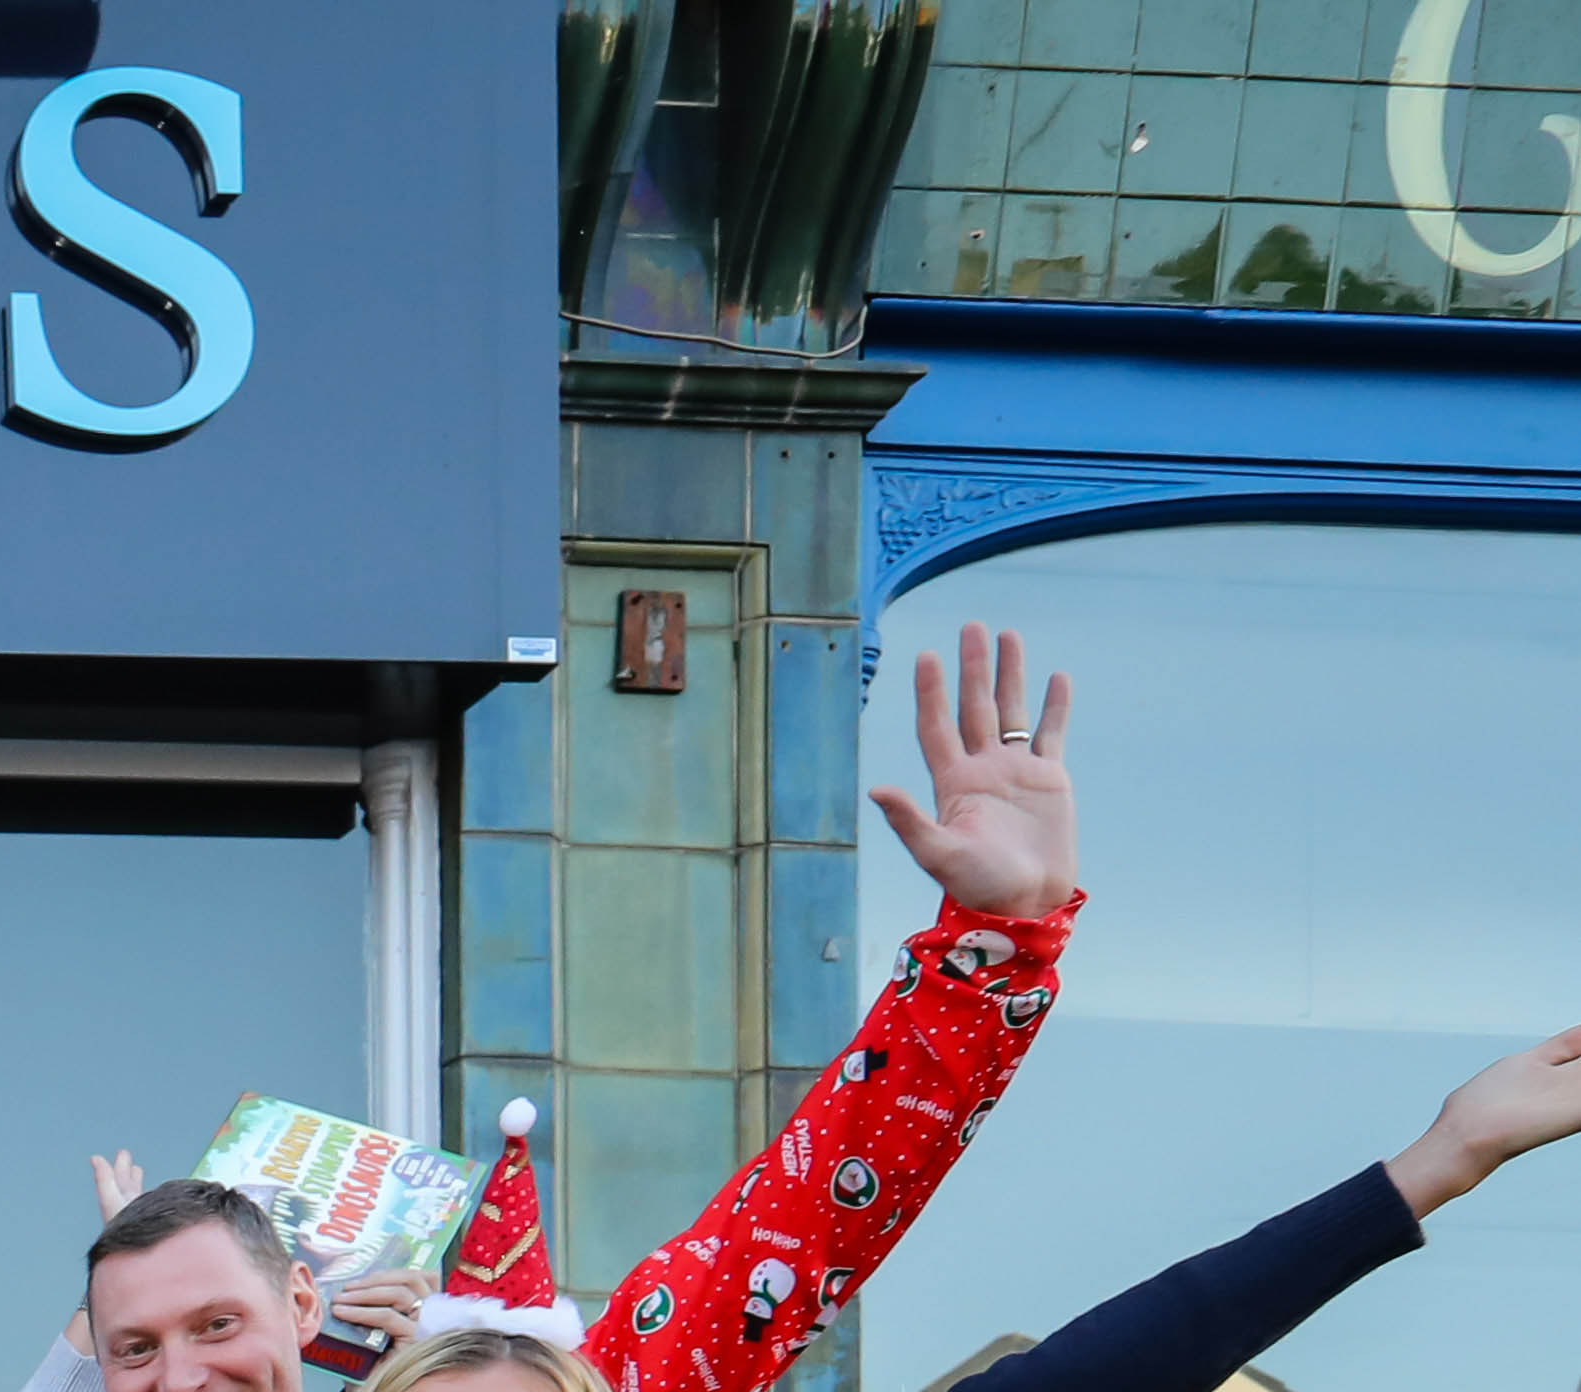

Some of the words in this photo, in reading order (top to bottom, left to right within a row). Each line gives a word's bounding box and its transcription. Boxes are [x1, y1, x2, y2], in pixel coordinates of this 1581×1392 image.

[261, 1113, 322, 1184] ROARING
[298, 1123, 357, 1199] STOMPING
[316, 1133, 401, 1243] DINOSAURS!
